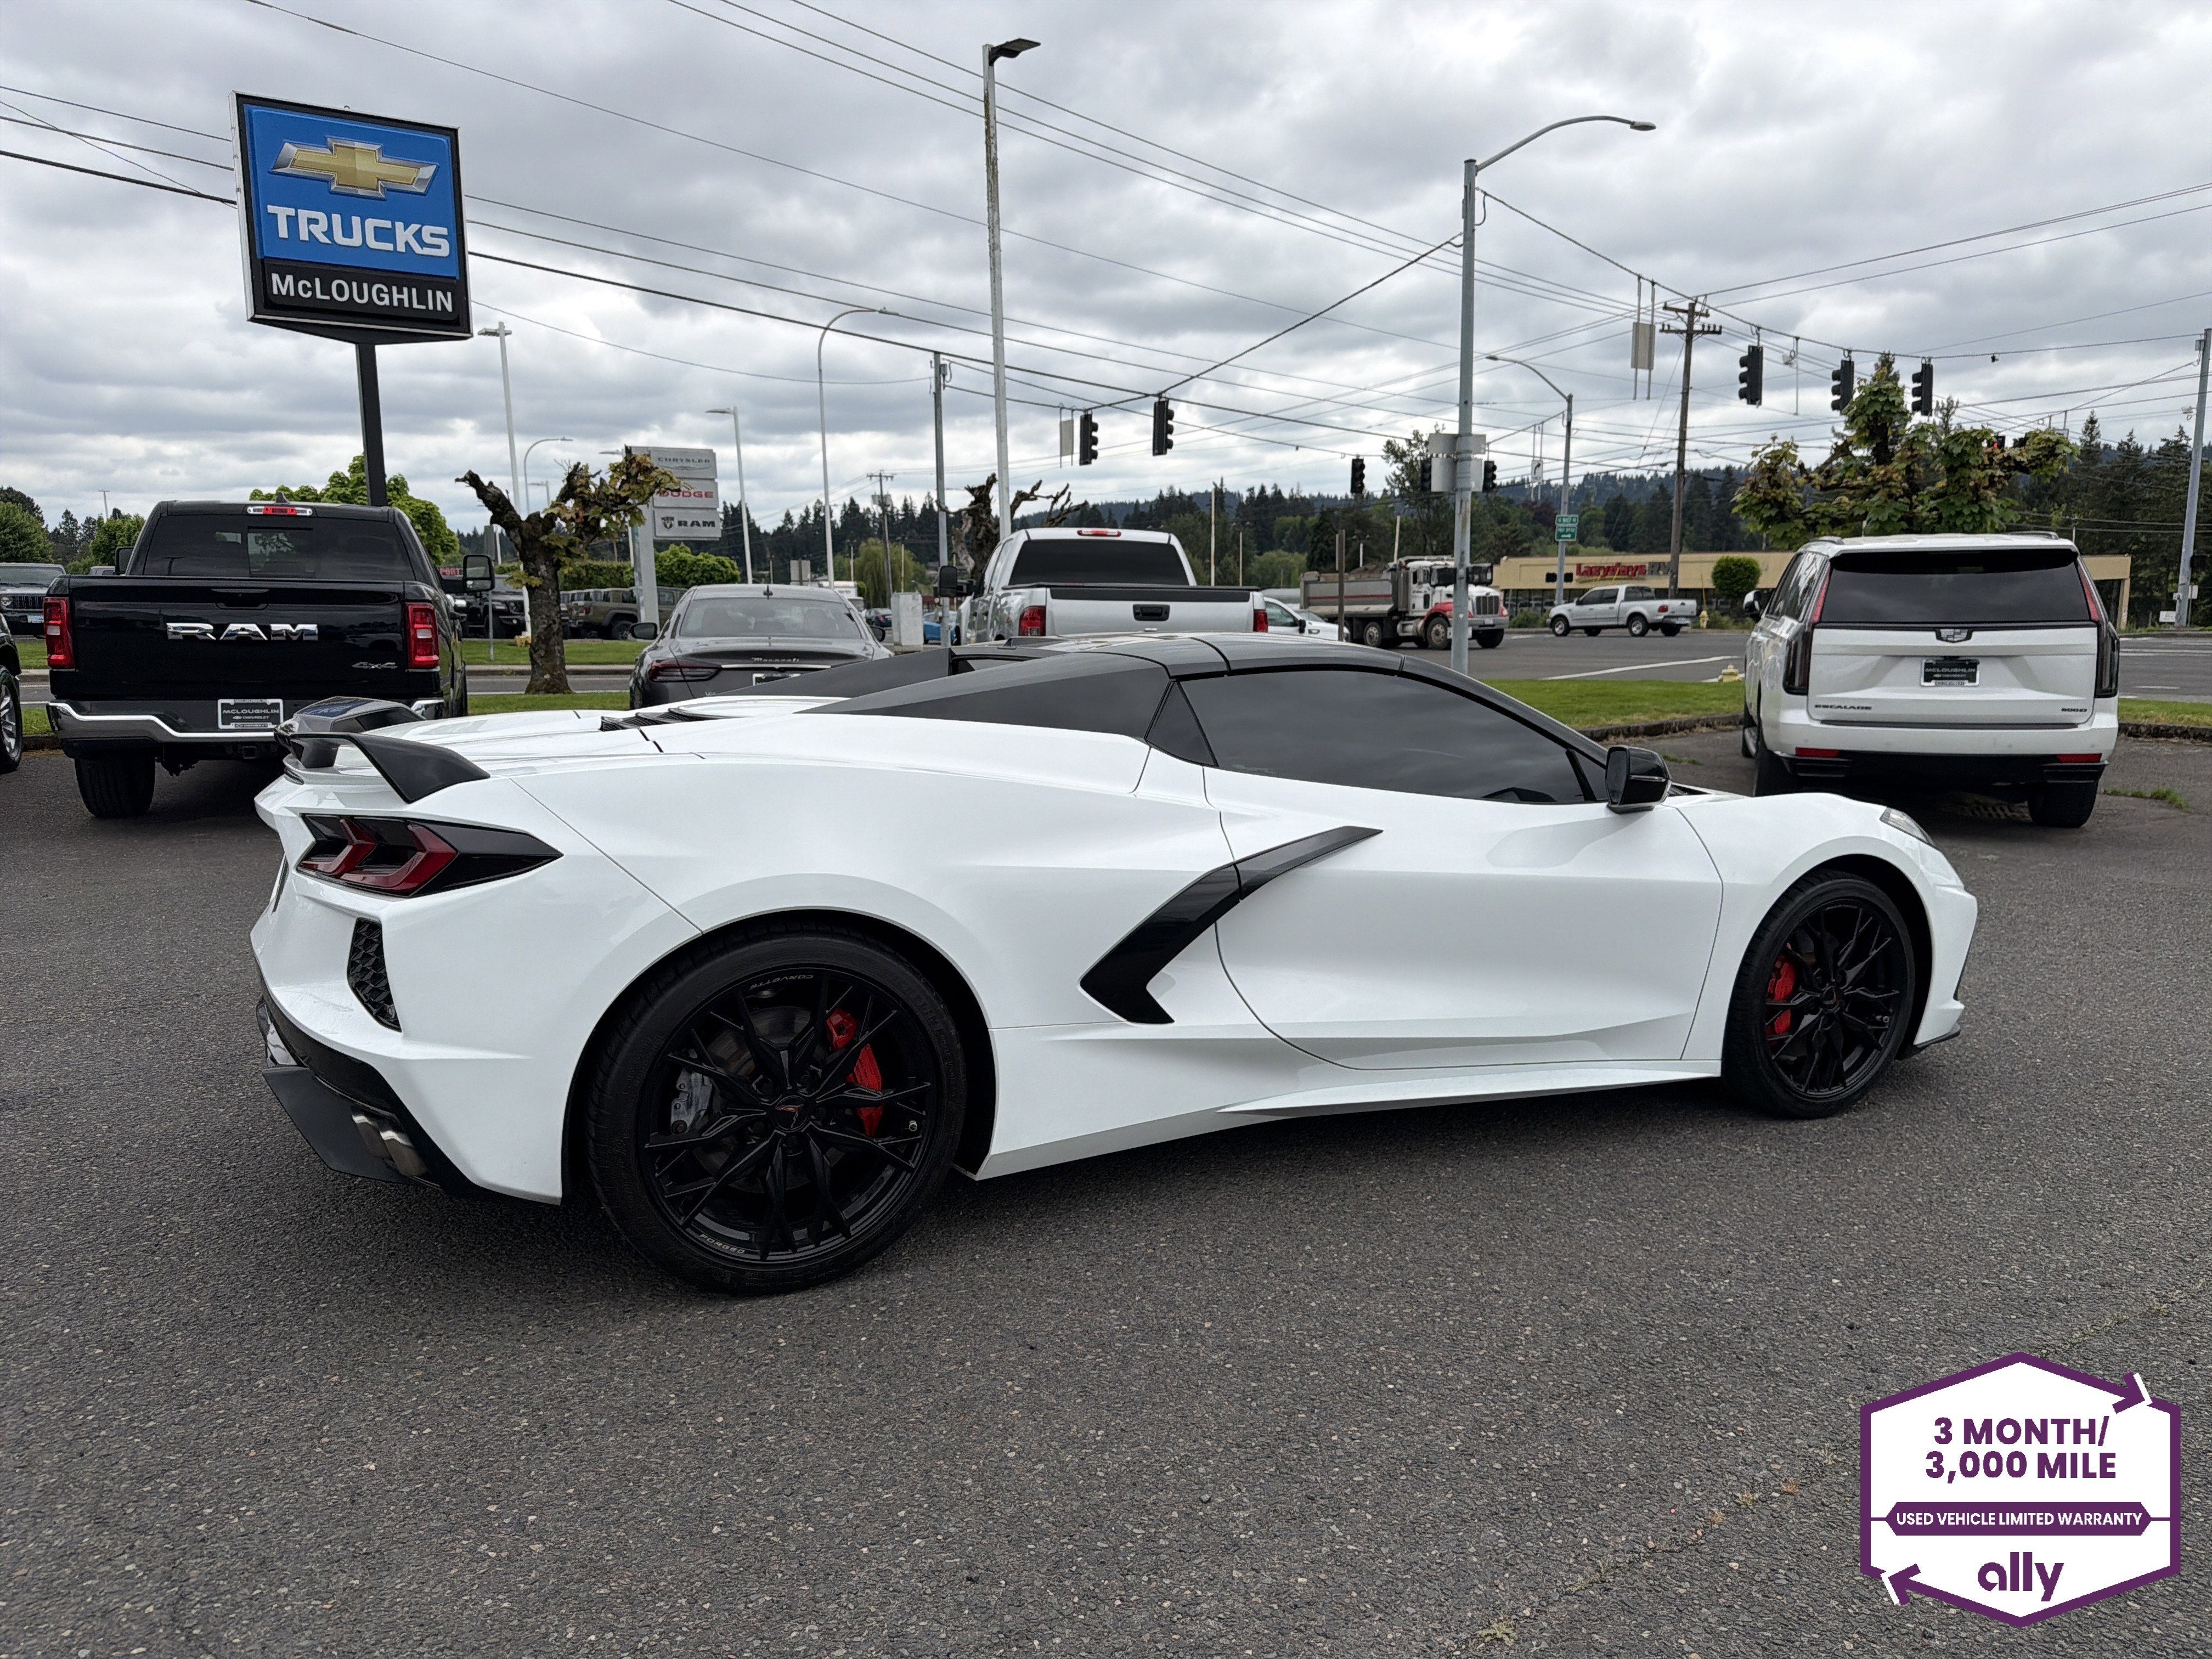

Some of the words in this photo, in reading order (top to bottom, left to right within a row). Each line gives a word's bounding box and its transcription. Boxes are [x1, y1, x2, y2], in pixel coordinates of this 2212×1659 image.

[267, 205, 450, 257] TRUCKS
[271, 273, 453, 312] McLOUGHLIN
[659, 490, 713, 498] DODGE
[1576, 562, 1646, 578] Lazydays
[166, 623, 319, 641] RAM
[749, 975, 814, 990] CORVETTE
[699, 1234, 746, 1254] FORGED
